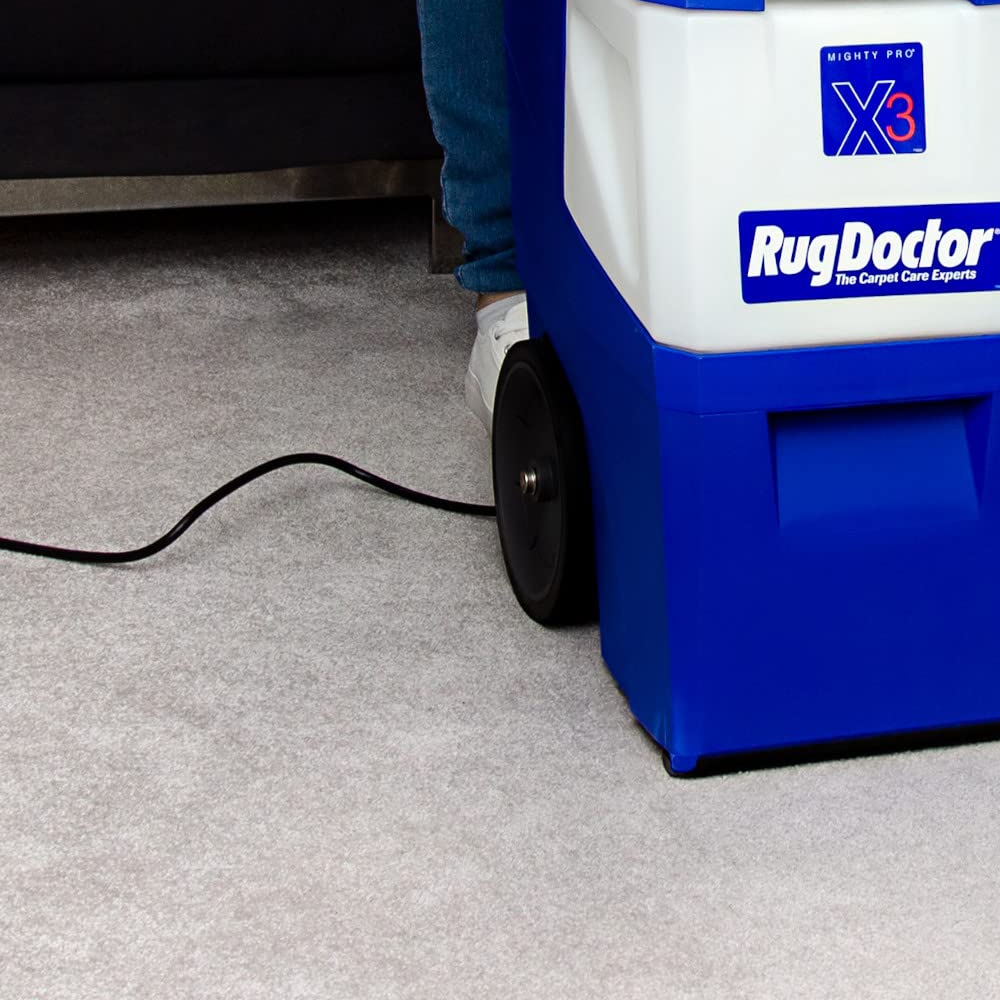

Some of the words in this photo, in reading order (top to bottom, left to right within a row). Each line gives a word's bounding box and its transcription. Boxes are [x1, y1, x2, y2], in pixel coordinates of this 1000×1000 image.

[827, 50, 878, 61] MIGHTY
[835, 273, 857, 286] The
[859, 271, 899, 286] Carpet
[901, 270, 929, 283] Care
[932, 268, 977, 284] Experts
